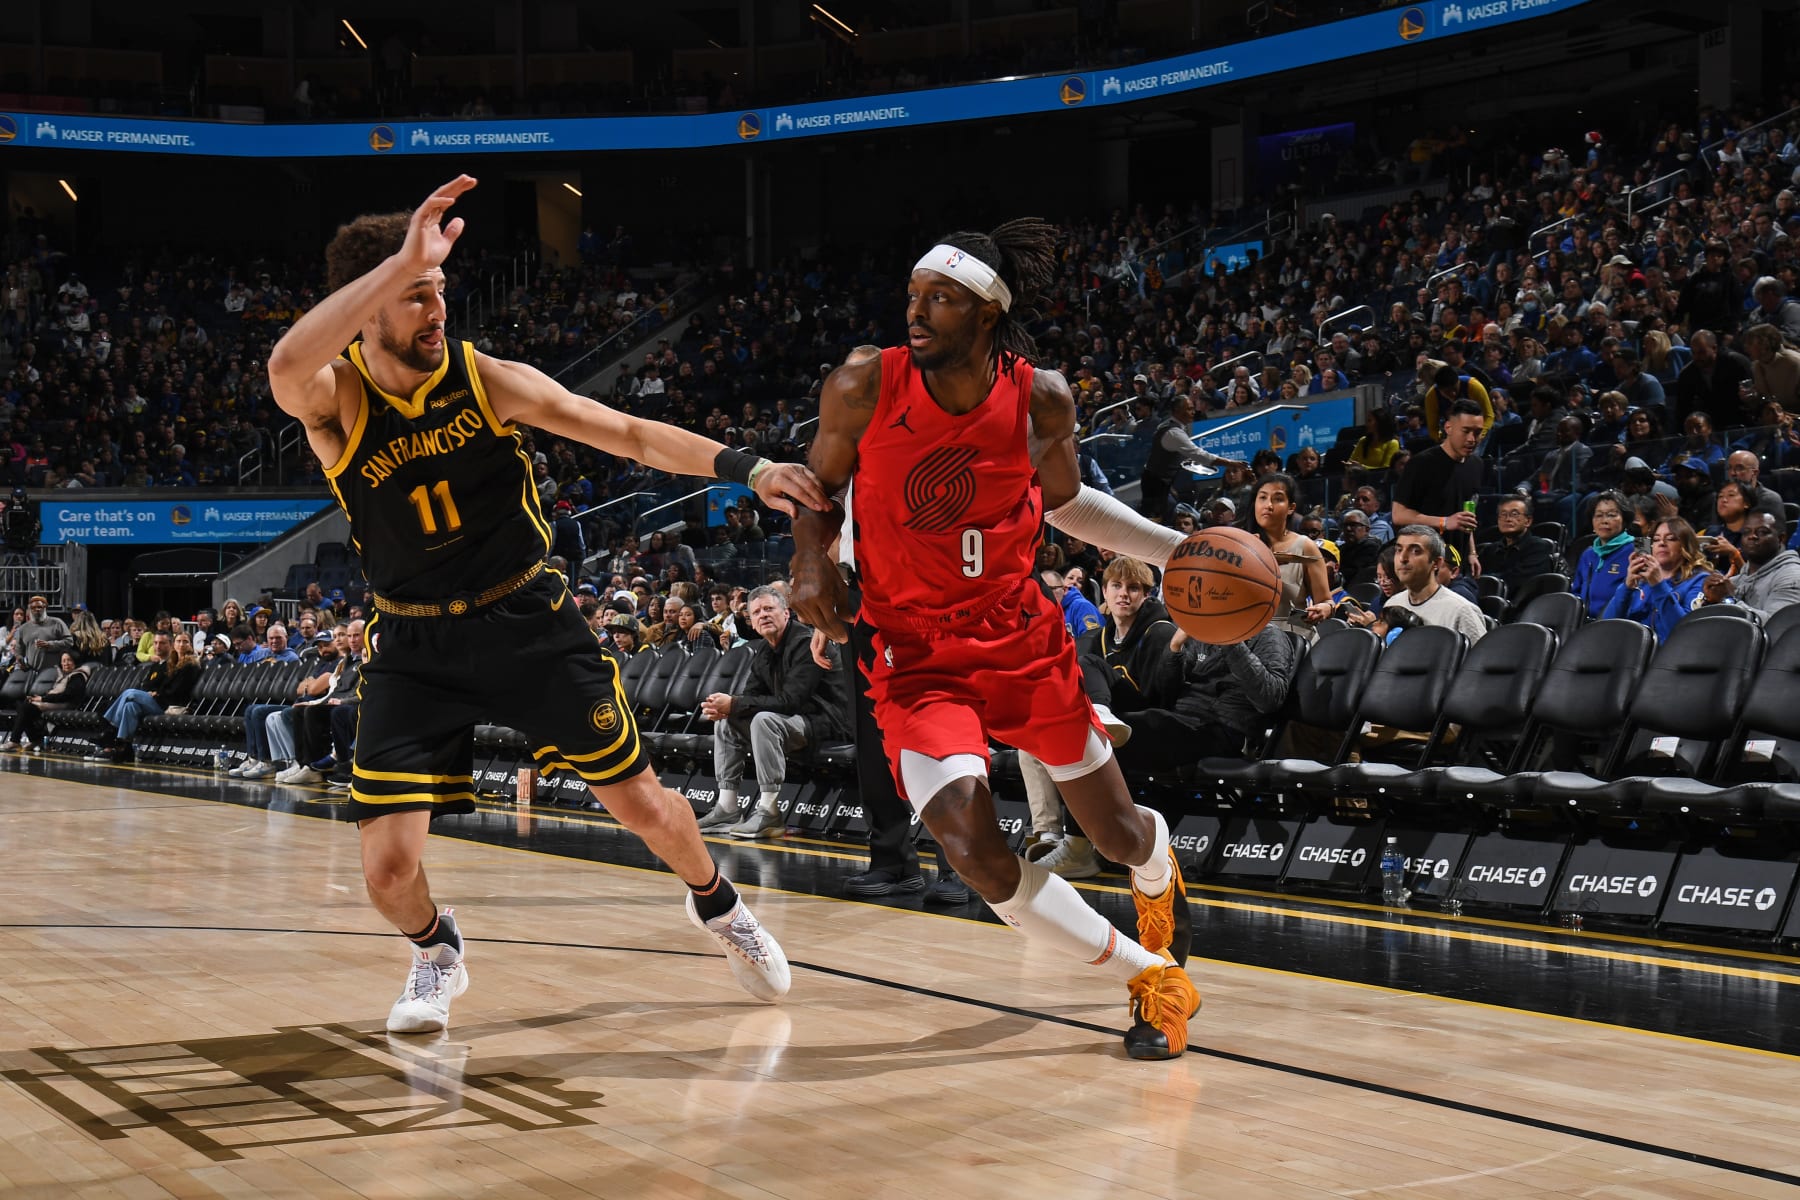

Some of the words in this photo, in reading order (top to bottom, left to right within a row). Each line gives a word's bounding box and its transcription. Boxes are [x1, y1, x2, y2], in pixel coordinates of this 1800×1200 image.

[1467, 2, 1508, 21] KAISER
[1125, 76, 1158, 93] KAISER
[796, 115, 831, 129] KAISER
[61, 129, 103, 142] KAISER
[434, 134, 471, 146] KAISER
[430, 389, 468, 409] Rakuten
[1199, 436, 1220, 448] Care
[1221, 430, 1247, 446] that's
[1248, 431, 1262, 443] on
[361, 450, 398, 489] SAN
[388, 408, 483, 466] FRANCISCO
[58, 509, 91, 522] Care
[94, 508, 134, 522] that's
[137, 512, 155, 522] on
[222, 511, 253, 521] KAISER
[408, 480, 462, 534] 11
[58, 527, 91, 541] your
[93, 525, 135, 537] team.
[961, 527, 984, 578] 9
[1172, 540, 1243, 569] Wilson
[686, 788, 709, 801] CHASE
[1169, 834, 1197, 850] ASE
[1222, 843, 1269, 859] CHASE
[1299, 846, 1351, 864] CHASE
[1403, 857, 1433, 875] ASE
[1468, 865, 1529, 885] CHASE
[1569, 874, 1637, 895] CHASE
[1678, 884, 1754, 907] CHASE
